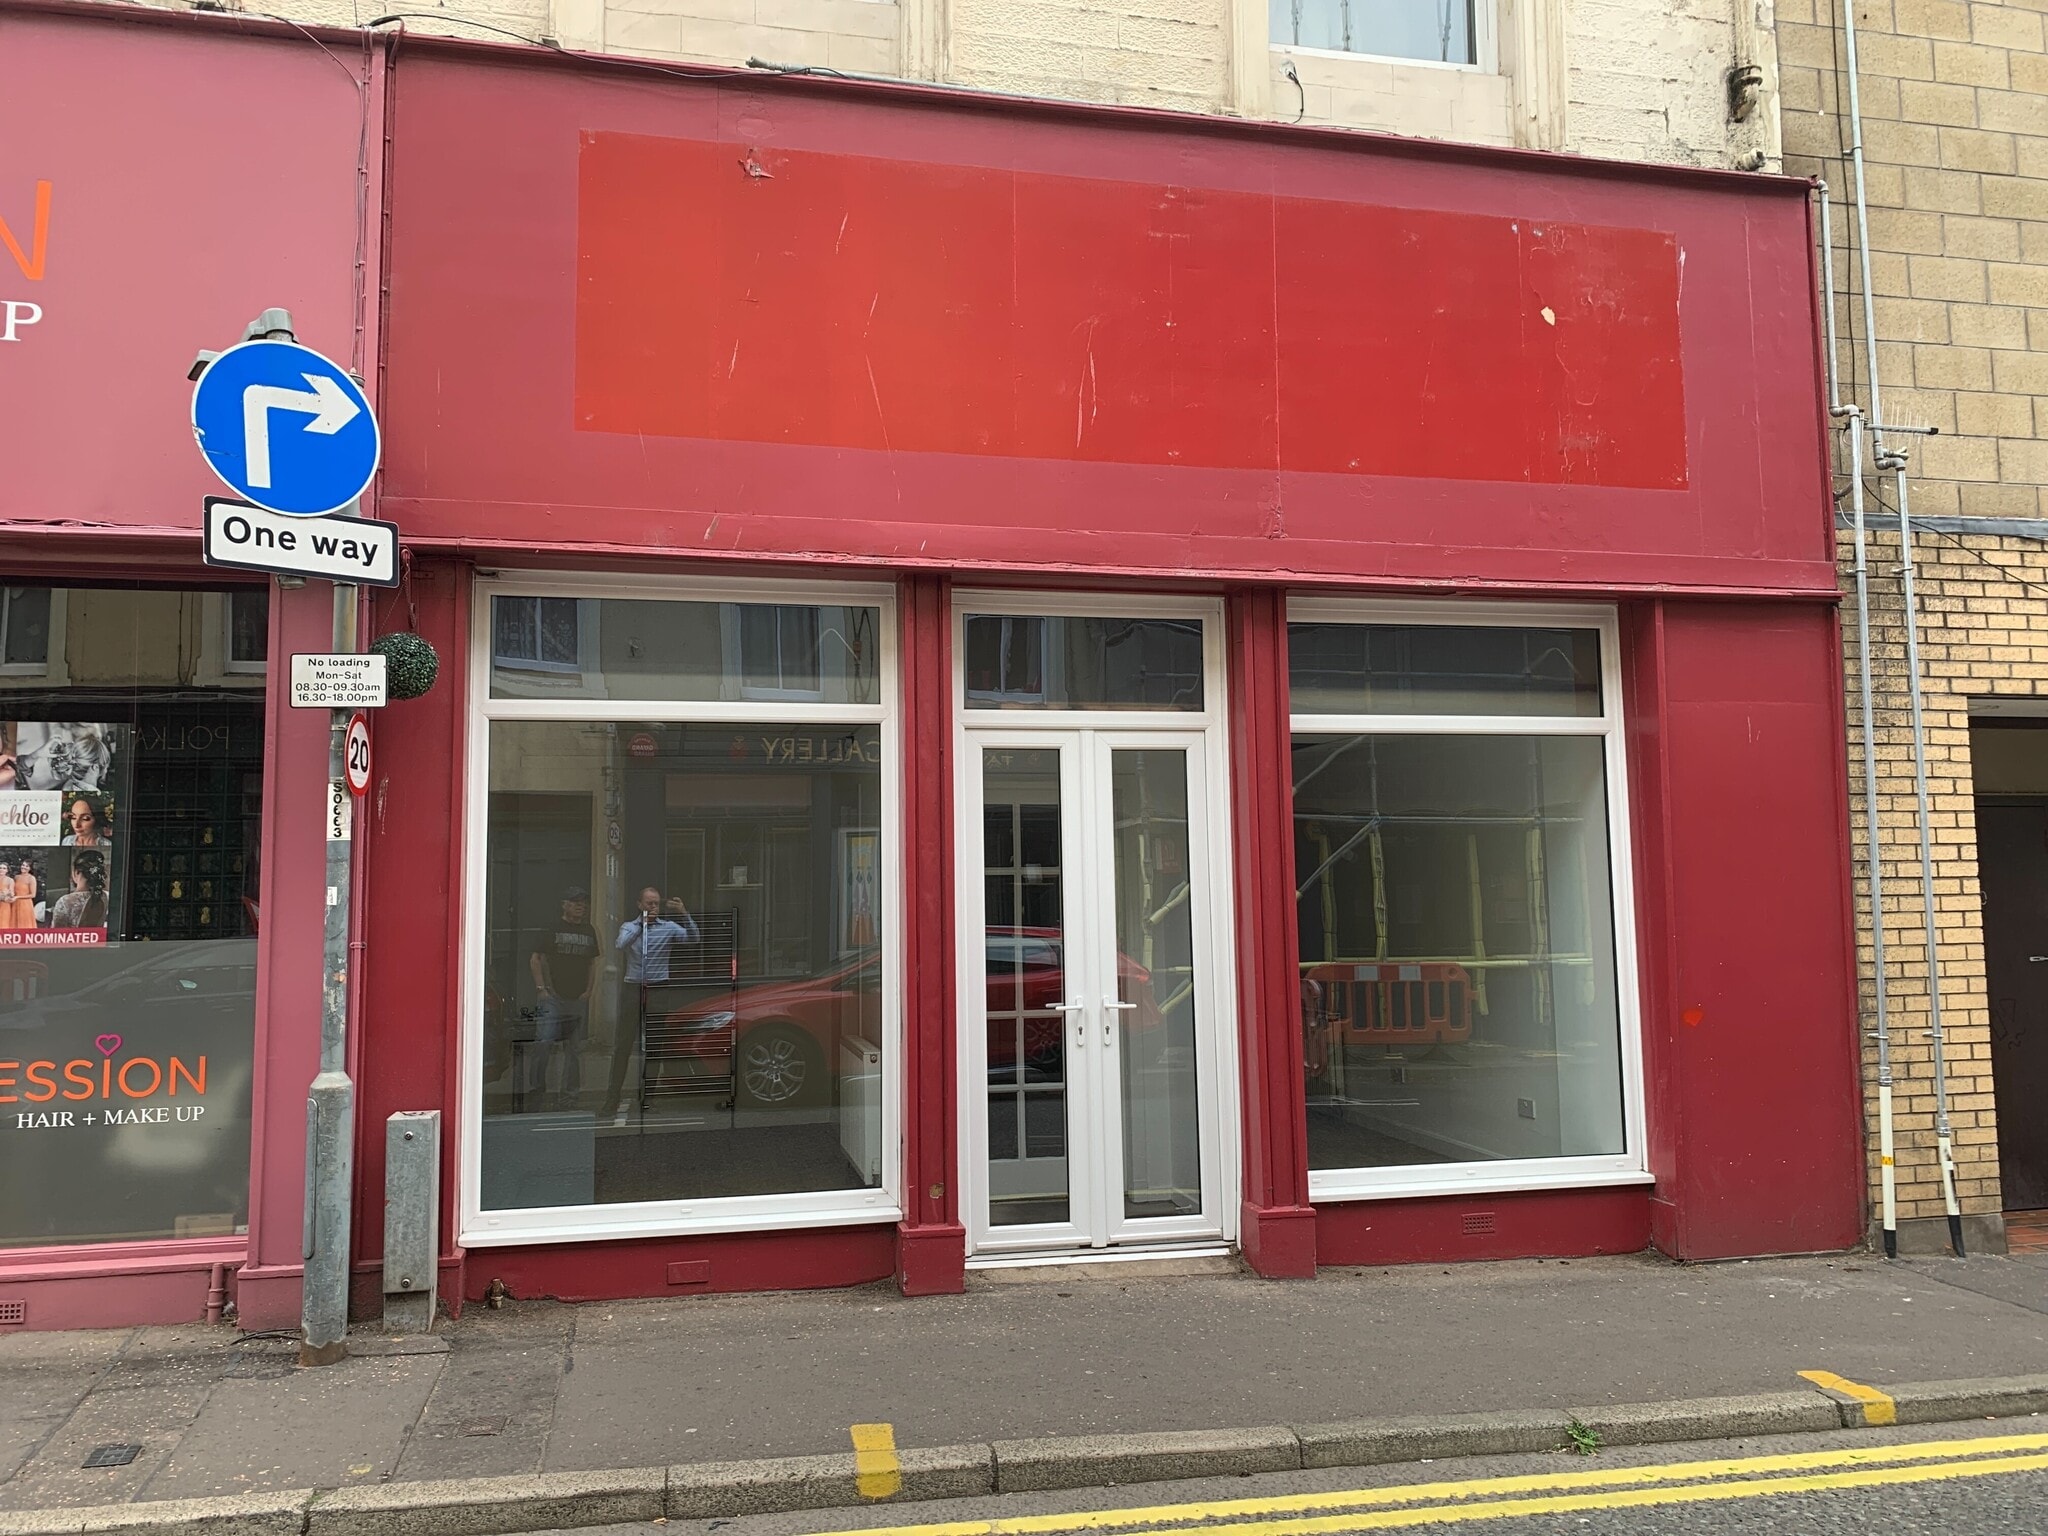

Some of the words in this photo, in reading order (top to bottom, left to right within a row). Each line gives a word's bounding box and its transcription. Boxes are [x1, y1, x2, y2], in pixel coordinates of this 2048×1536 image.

[0, 300, 43, 342] P
[223, 516, 297, 551] One
[311, 534, 378, 567] way
[308, 658, 326, 667] No
[328, 657, 370, 668] loading
[316, 671, 362, 680] Mon-Sat
[295, 683, 381, 692] 08.30-09.30am
[298, 693, 378, 703] 16.30-18.00pm
[349, 736, 369, 773] 20
[1, 803, 50, 827] chloe
[0, 933, 22, 945] RD
[25, 932, 99, 944] NOMINATED
[16, 1111, 75, 1129] HAIR
[82, 1112, 97, 1126] +
[104, 1107, 170, 1125] MAKE
[176, 1106, 205, 1122] UP
